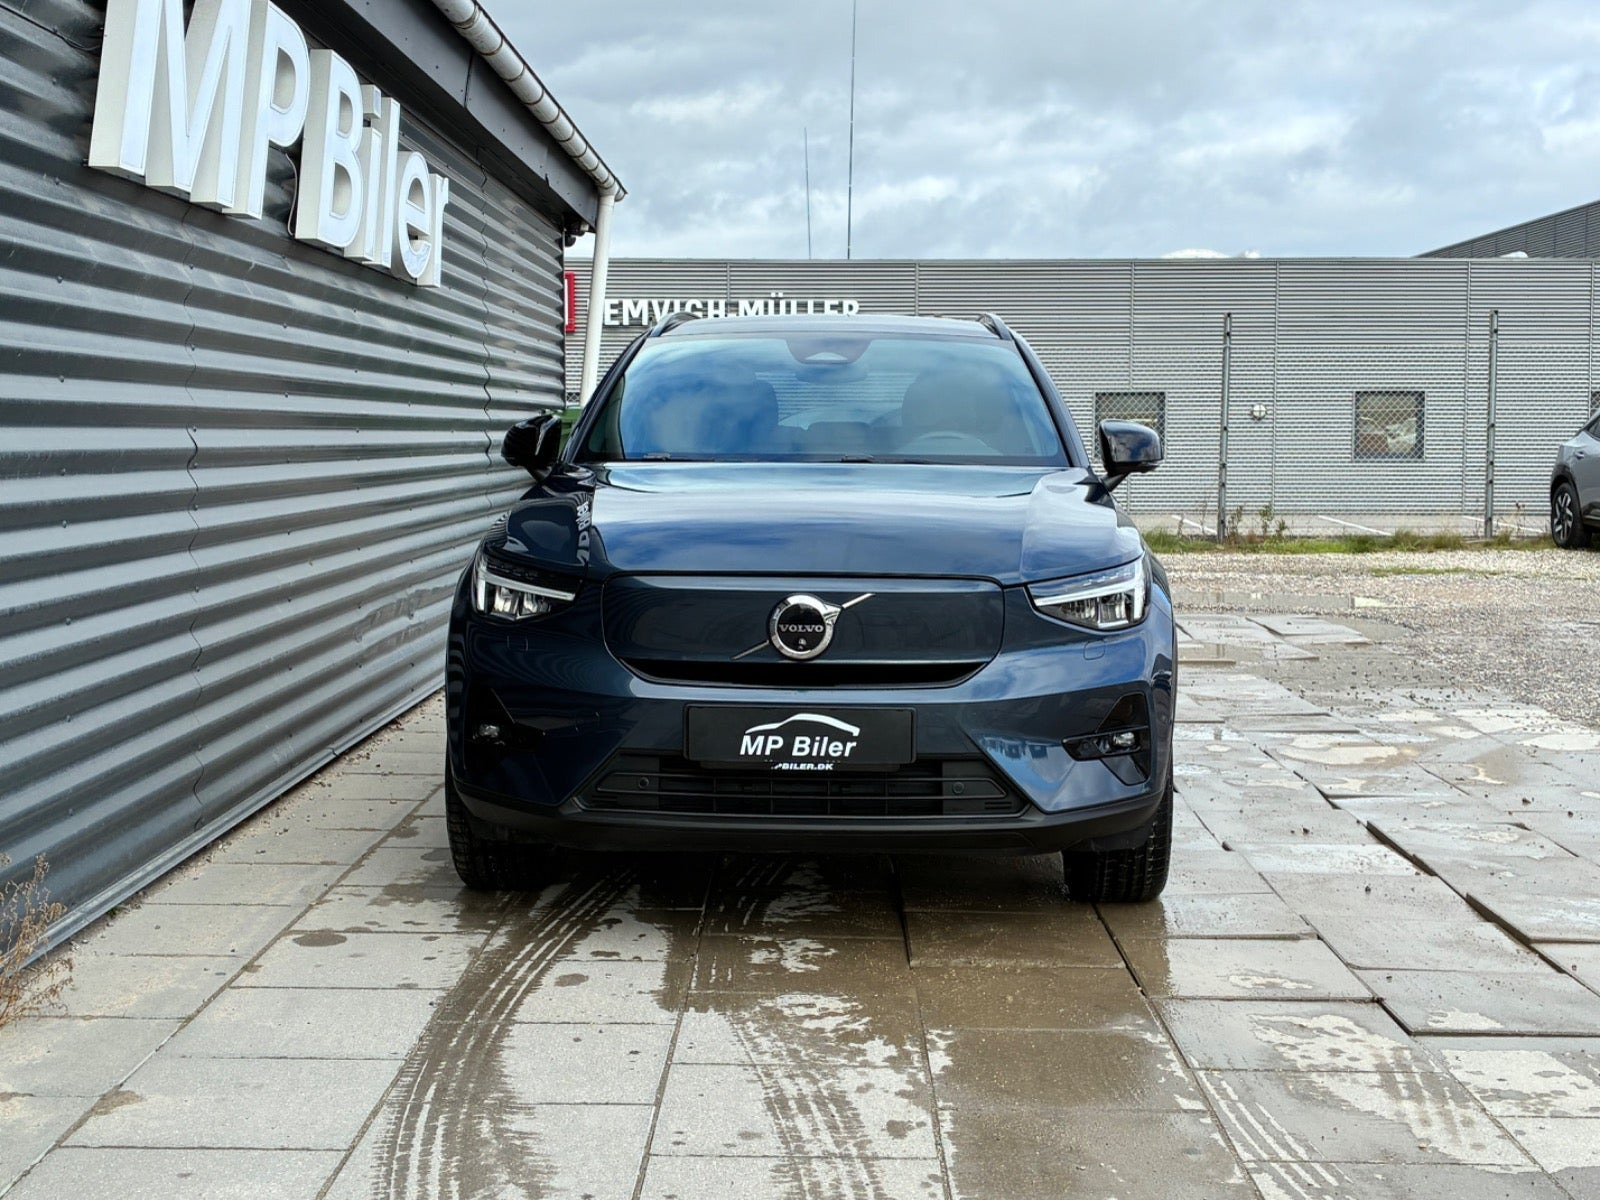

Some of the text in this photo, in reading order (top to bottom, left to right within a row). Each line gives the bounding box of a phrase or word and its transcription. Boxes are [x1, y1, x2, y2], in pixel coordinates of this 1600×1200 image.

[89, 0, 449, 288] MP Biler
[587, 291, 860, 326] EMVIGH-MÜER
[779, 624, 824, 633] VOLVO
[739, 735, 857, 758] MP Biler
[770, 761, 834, 771] BILER.DK
